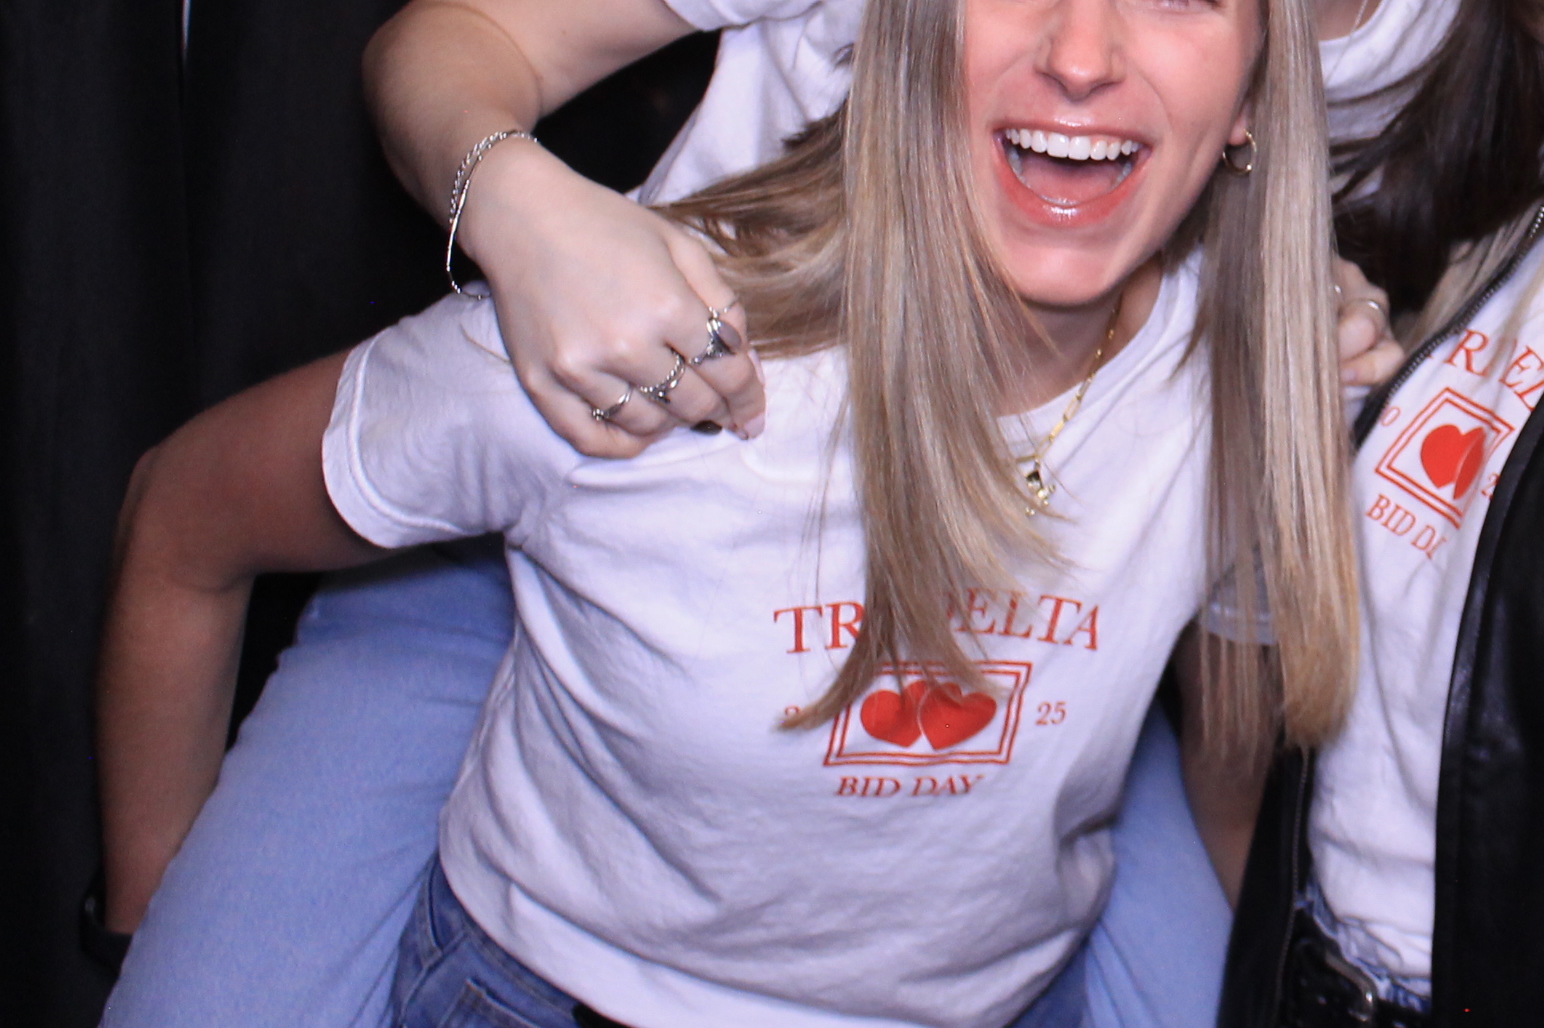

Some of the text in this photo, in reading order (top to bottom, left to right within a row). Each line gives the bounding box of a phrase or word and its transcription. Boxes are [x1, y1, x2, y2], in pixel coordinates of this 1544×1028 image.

[1365, 493, 1417, 536] BID
[773, 587, 1099, 653] TR ELTA
[1036, 702, 1066, 725] 25
[836, 775, 983, 797] BID DAY
